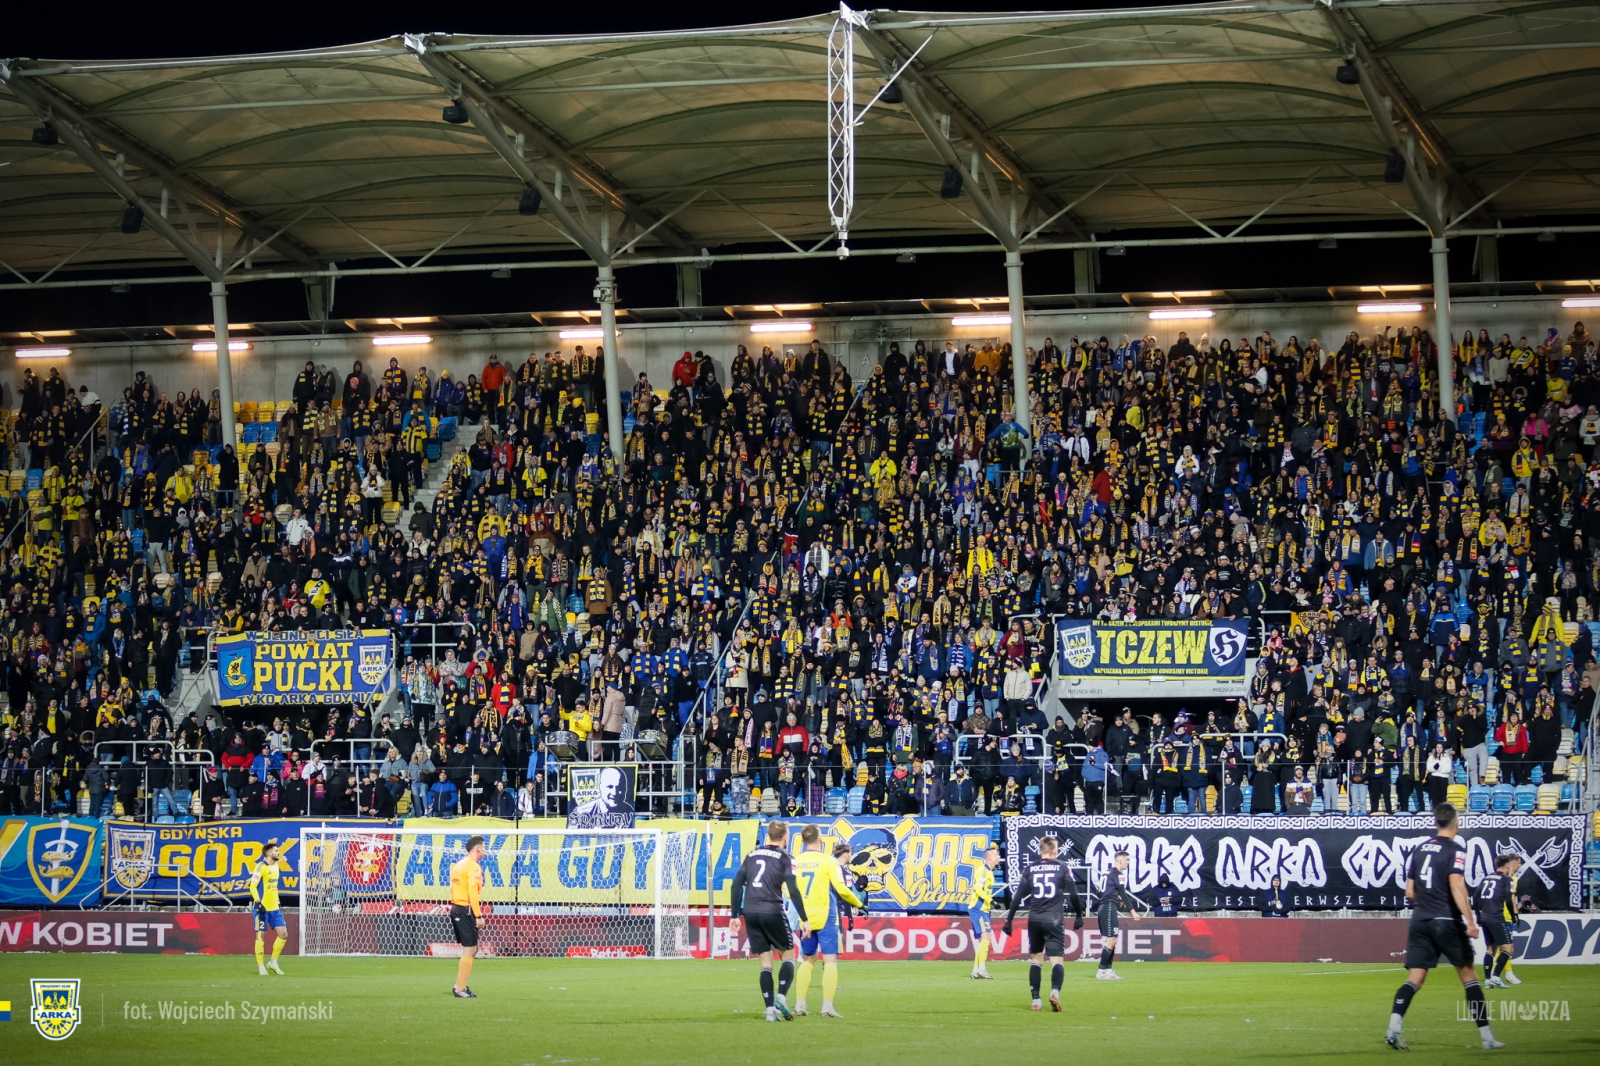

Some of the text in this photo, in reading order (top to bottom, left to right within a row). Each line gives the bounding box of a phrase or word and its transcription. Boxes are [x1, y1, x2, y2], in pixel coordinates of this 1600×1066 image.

[263, 630, 331, 642] JEDNOCI
[335, 629, 365, 641] SIŁA
[1096, 629, 1208, 665] TCZEW
[255, 642, 354, 660] POWIAT
[1068, 647, 1092, 657] ARKA
[253, 660, 354, 692] PUCKI
[279, 692, 317, 705] ARKA
[323, 692, 376, 705] GDYNIA
[160, 826, 243, 841] GDYŃSKA
[403, 831, 742, 890] ARKA GDYNIA
[1214, 836, 1327, 890] ARKA
[1420, 854, 1433, 889] 4
[752, 859, 766, 888] 2
[802, 871, 815, 899] 7
[1033, 873, 1056, 899] 55
[1213, 896, 1256, 907] JEST
[1481, 880, 1497, 900] 23
[32, 922, 174, 947] KOBIET
